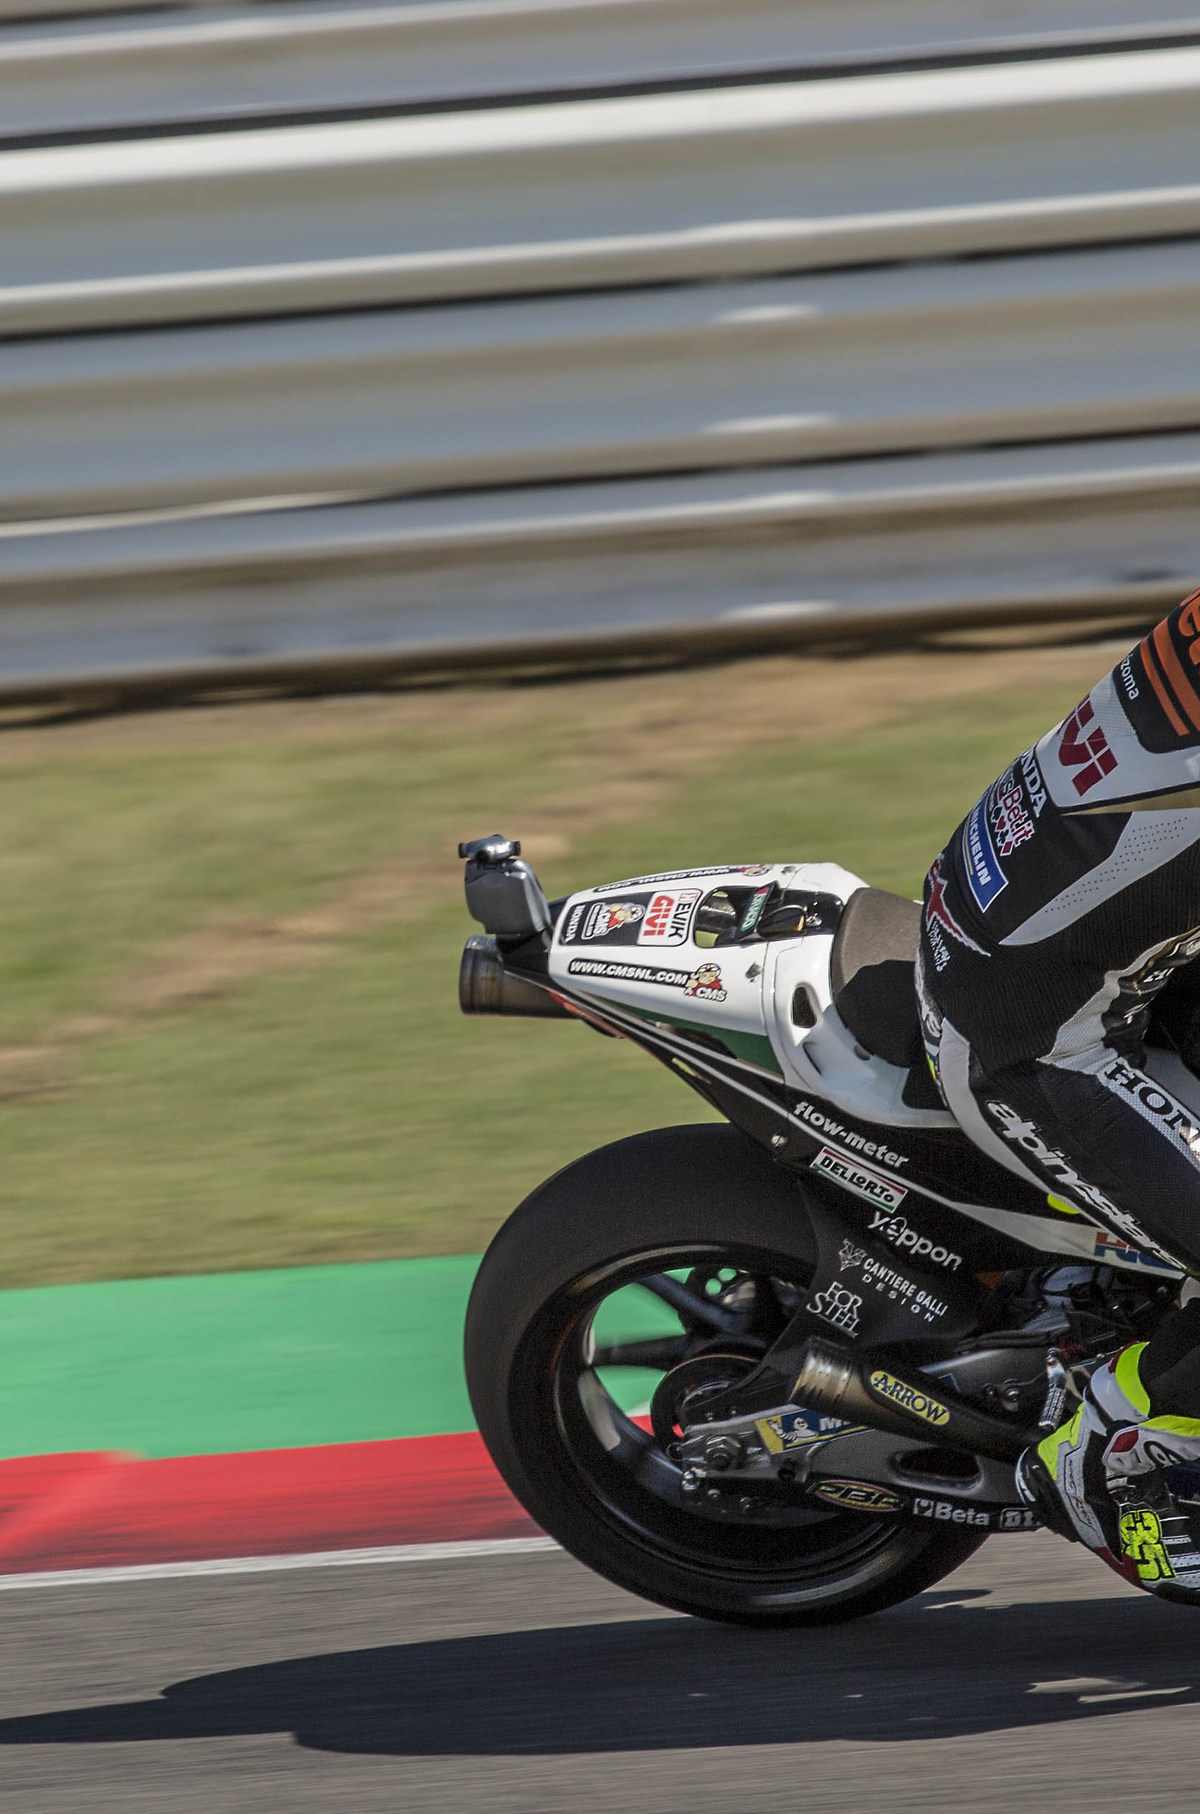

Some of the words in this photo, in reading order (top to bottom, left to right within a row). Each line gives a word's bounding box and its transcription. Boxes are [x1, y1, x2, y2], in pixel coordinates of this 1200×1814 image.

[565, 905, 586, 943] HONDA
[643, 895, 674, 936] GIVI
[669, 892, 698, 938] HEVIK
[570, 960, 688, 985] WWW.CMSNL.COM
[792, 1100, 908, 1169] flow-meter
[862, 1274, 935, 1323] DESIGN
[864, 1258, 917, 1297] CANTIERE
[915, 1290, 949, 1317] GALLI
[934, 1502, 990, 1526] Beta
[1120, 1509, 1177, 1582] 35
